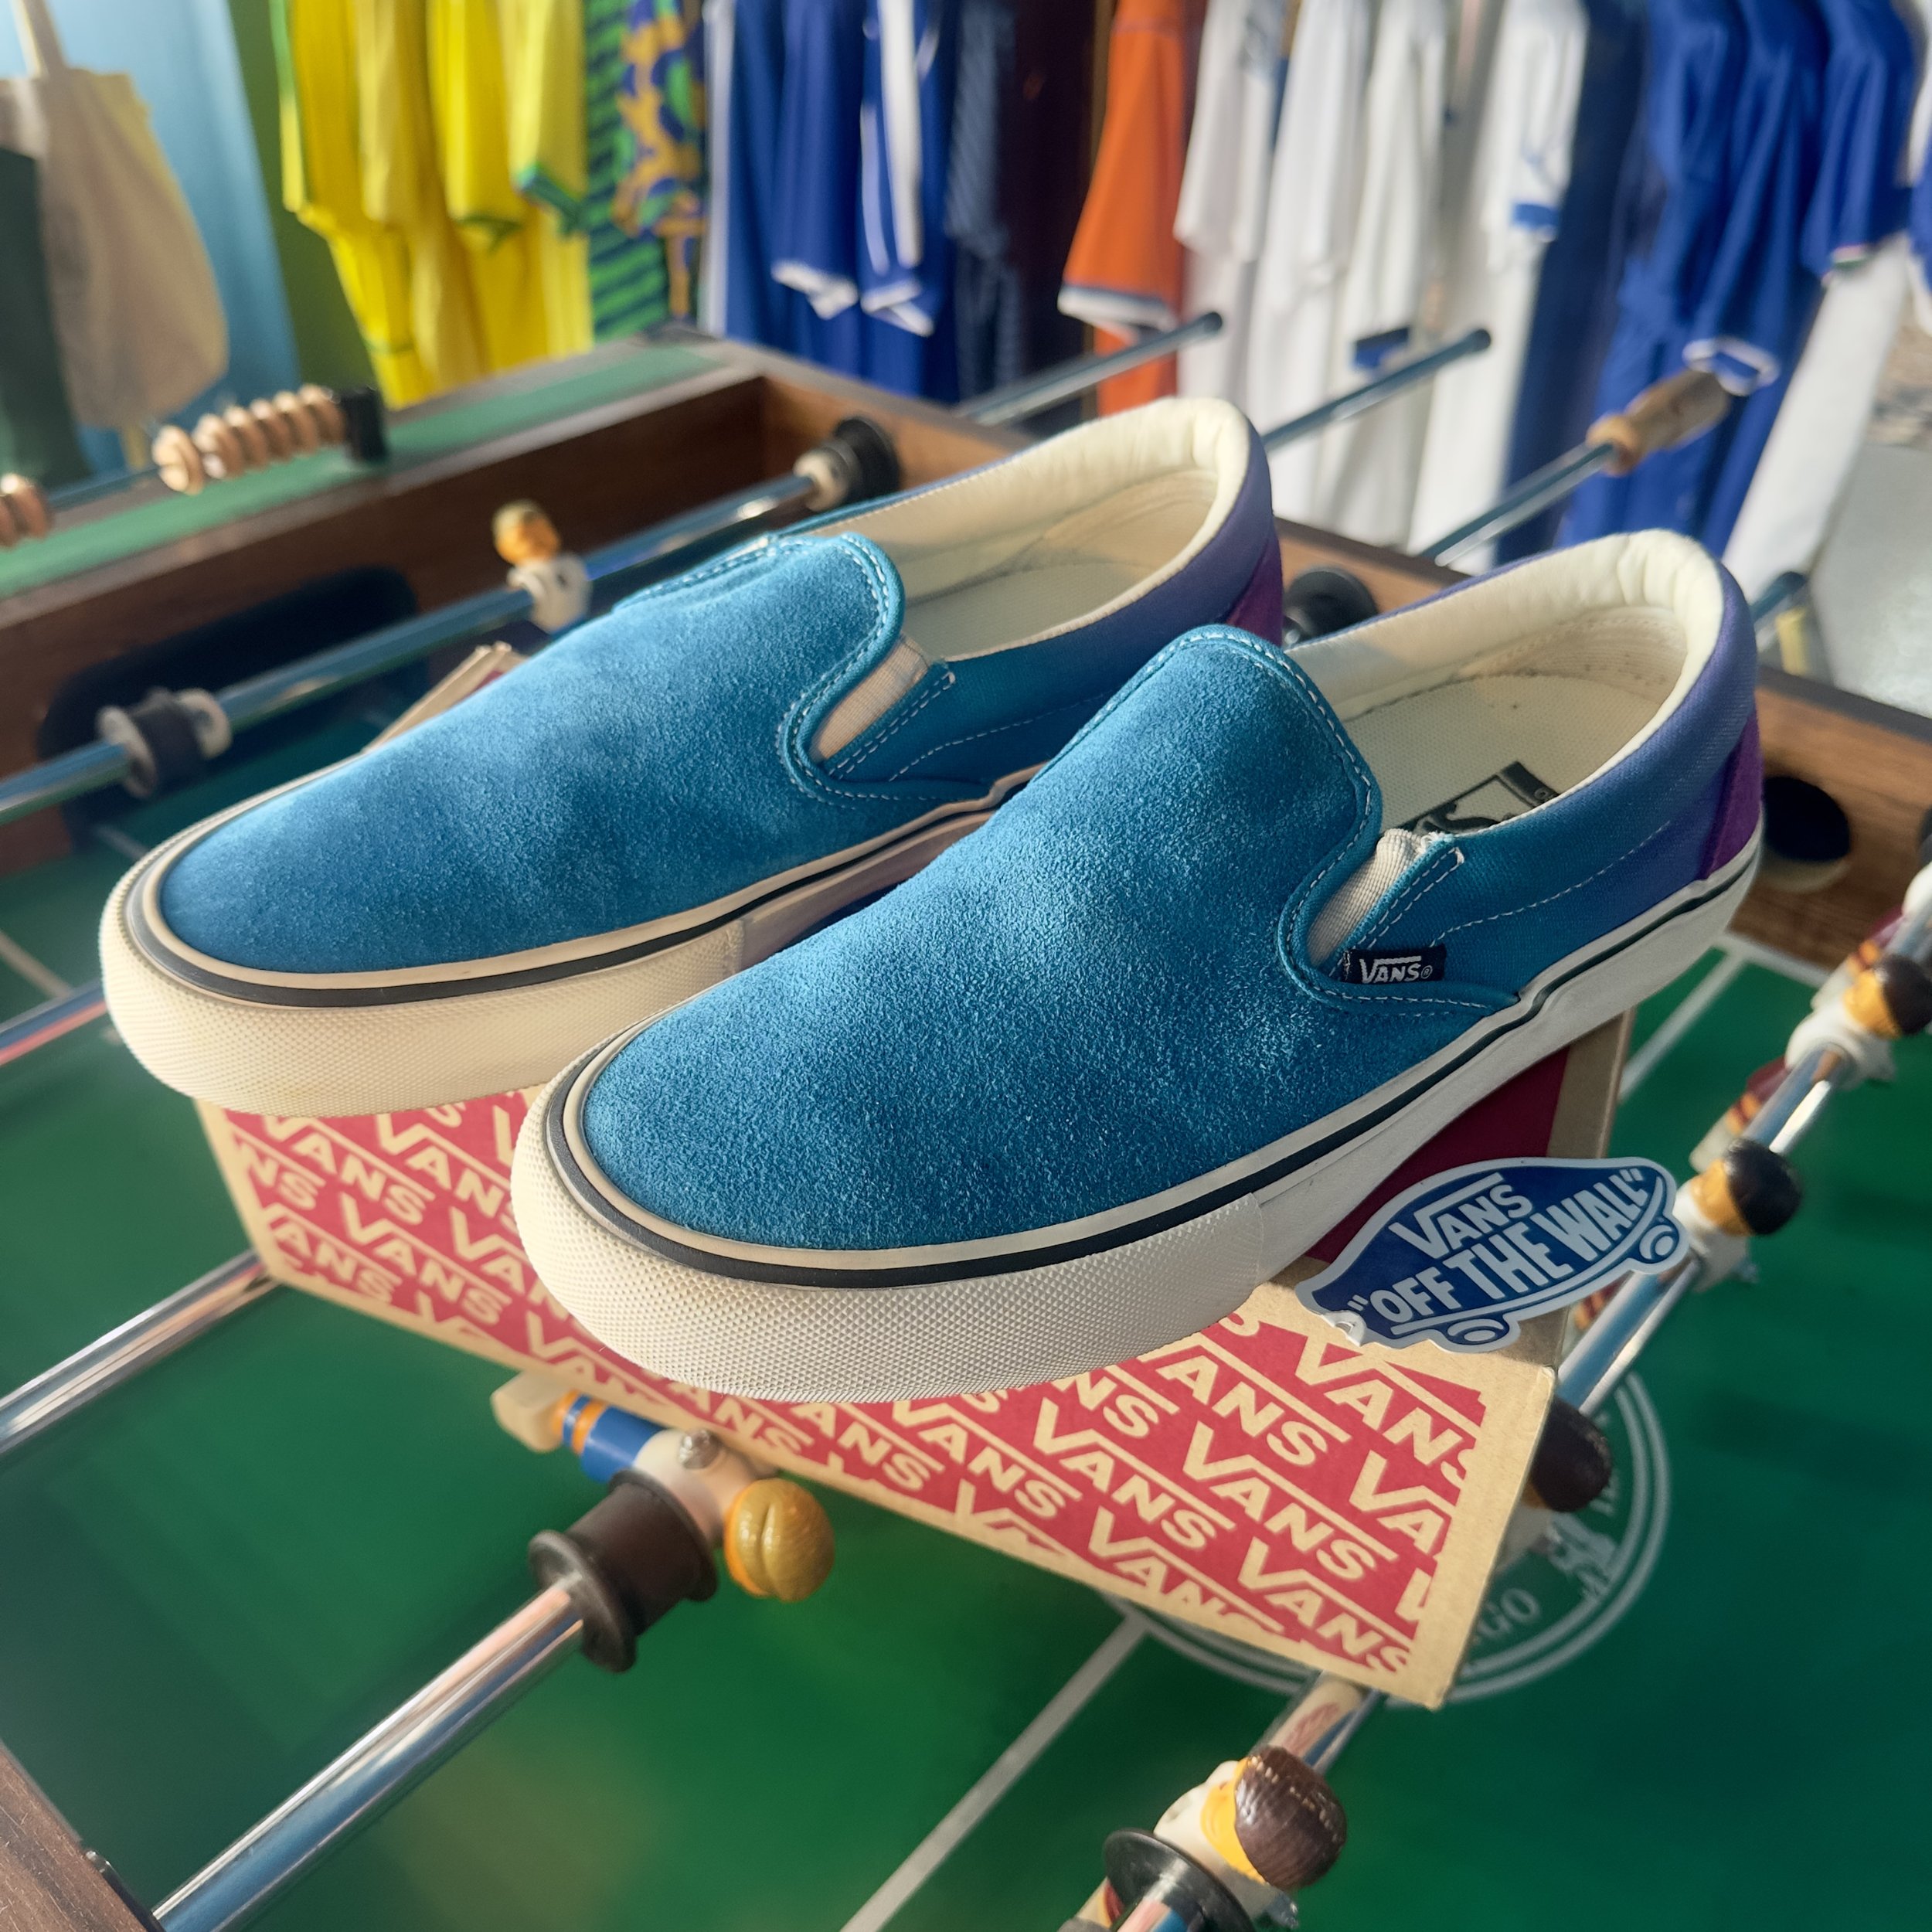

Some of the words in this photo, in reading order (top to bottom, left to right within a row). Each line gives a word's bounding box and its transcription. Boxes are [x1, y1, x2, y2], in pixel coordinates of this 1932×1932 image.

[338, 1191, 513, 1326] VANS
[1348, 1266, 1462, 1323] "OFF
[1443, 1219, 1573, 1300] THE
[1532, 1168, 1648, 1262] WALL"
[1389, 1172, 1534, 1259] VANS
[790, 1402, 946, 1492] ANS
[892, 1400, 1083, 1519] VANS
[1033, 1396, 1236, 1549] VANS
[1182, 1420, 1400, 1580] VANS
